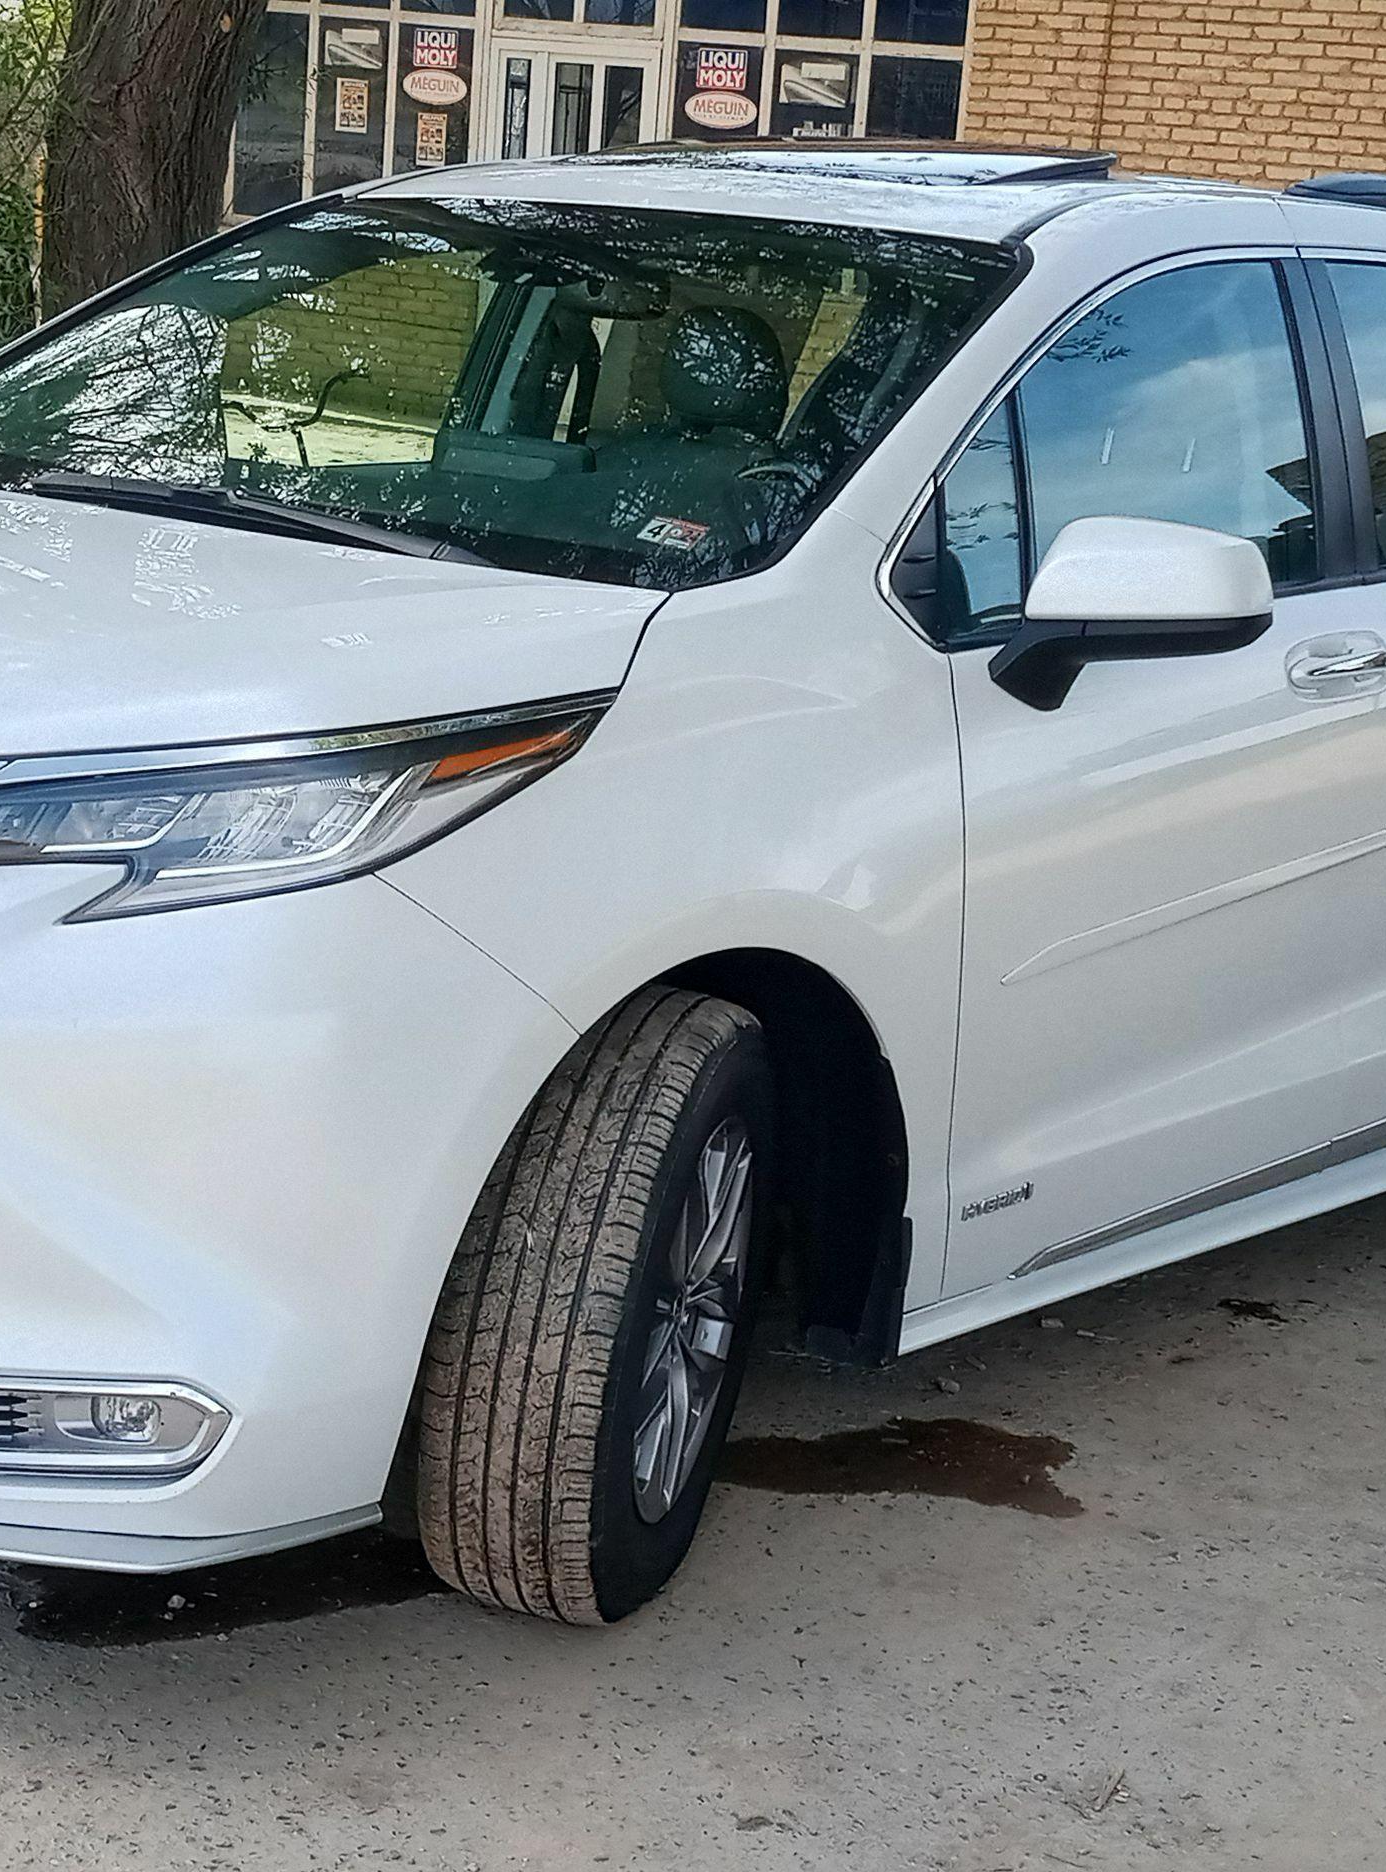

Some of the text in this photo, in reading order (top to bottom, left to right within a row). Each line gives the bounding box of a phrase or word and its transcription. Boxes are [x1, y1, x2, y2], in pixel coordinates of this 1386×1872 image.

[416, 30, 456, 48] LIQUI
[415, 48, 457, 66] MOLY
[700, 50, 745, 69] LIQUI
[698, 69, 745, 88] MOLY
